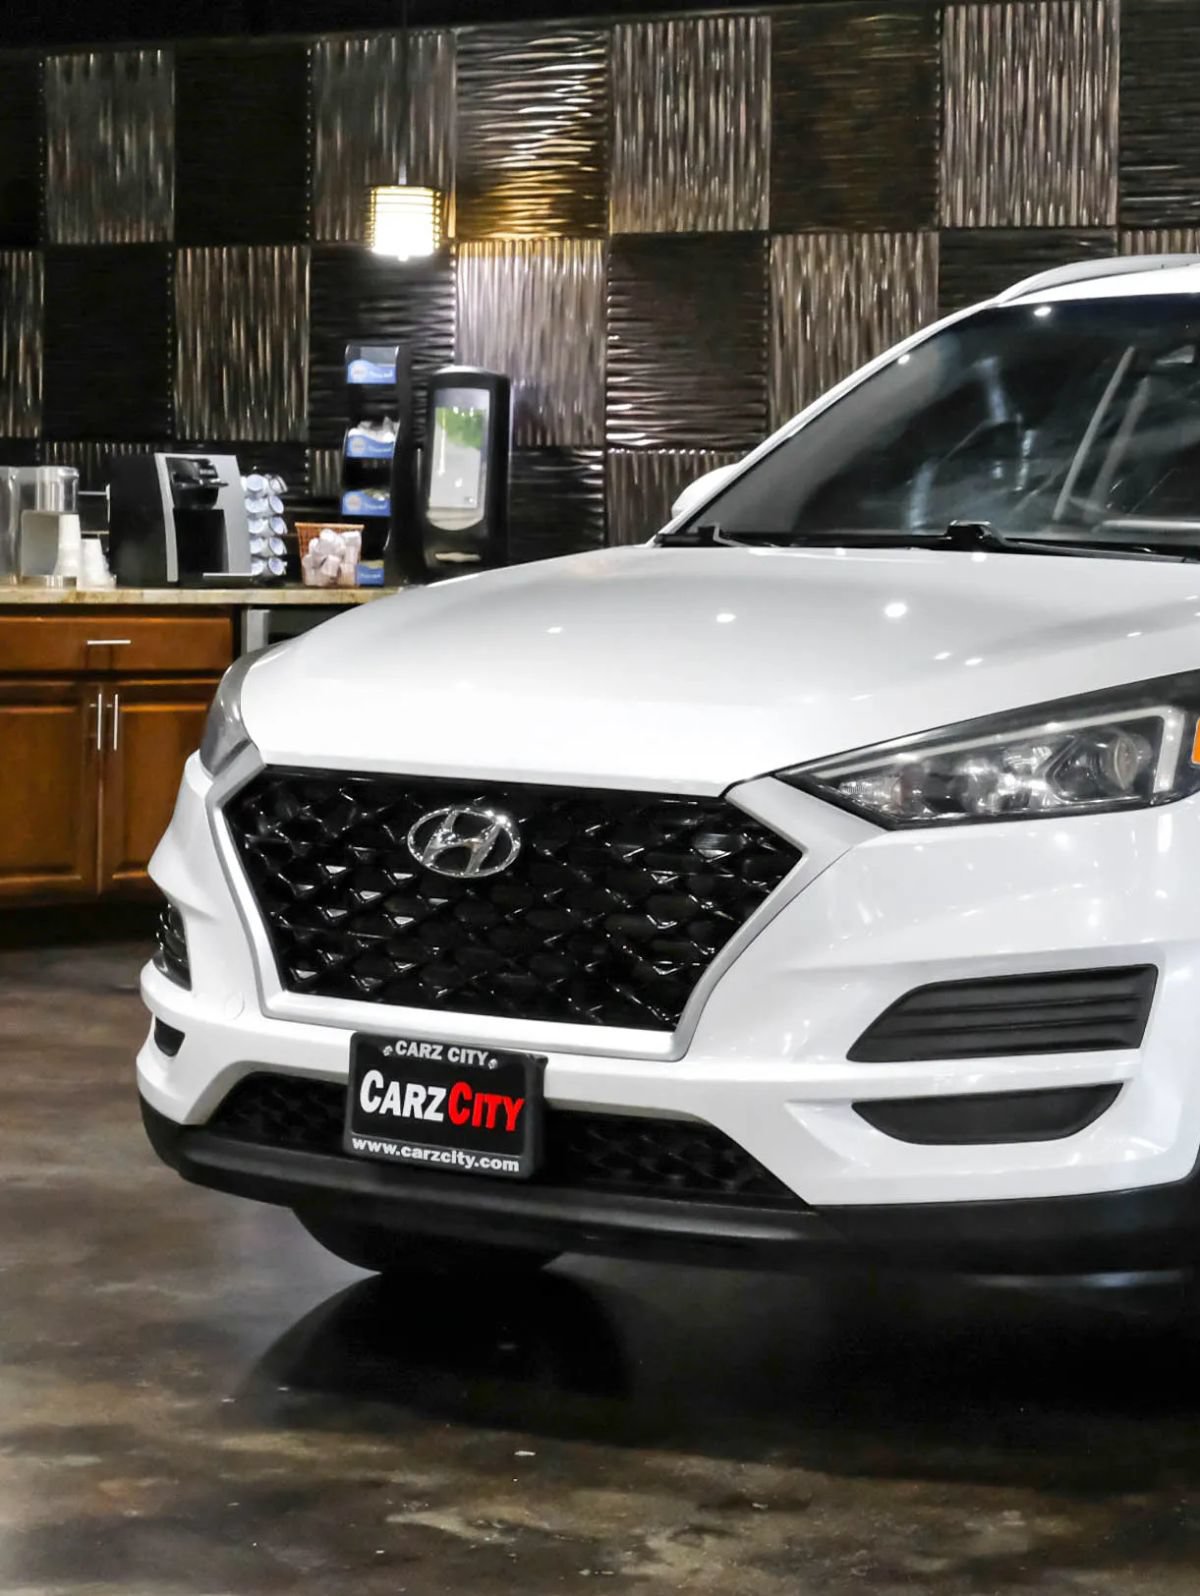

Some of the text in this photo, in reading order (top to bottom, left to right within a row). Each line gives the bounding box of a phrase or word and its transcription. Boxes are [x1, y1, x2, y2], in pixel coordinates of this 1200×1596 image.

[395, 1040, 489, 1067] CARZ CITY
[352, 1137, 520, 1173] www.carzcity.com
